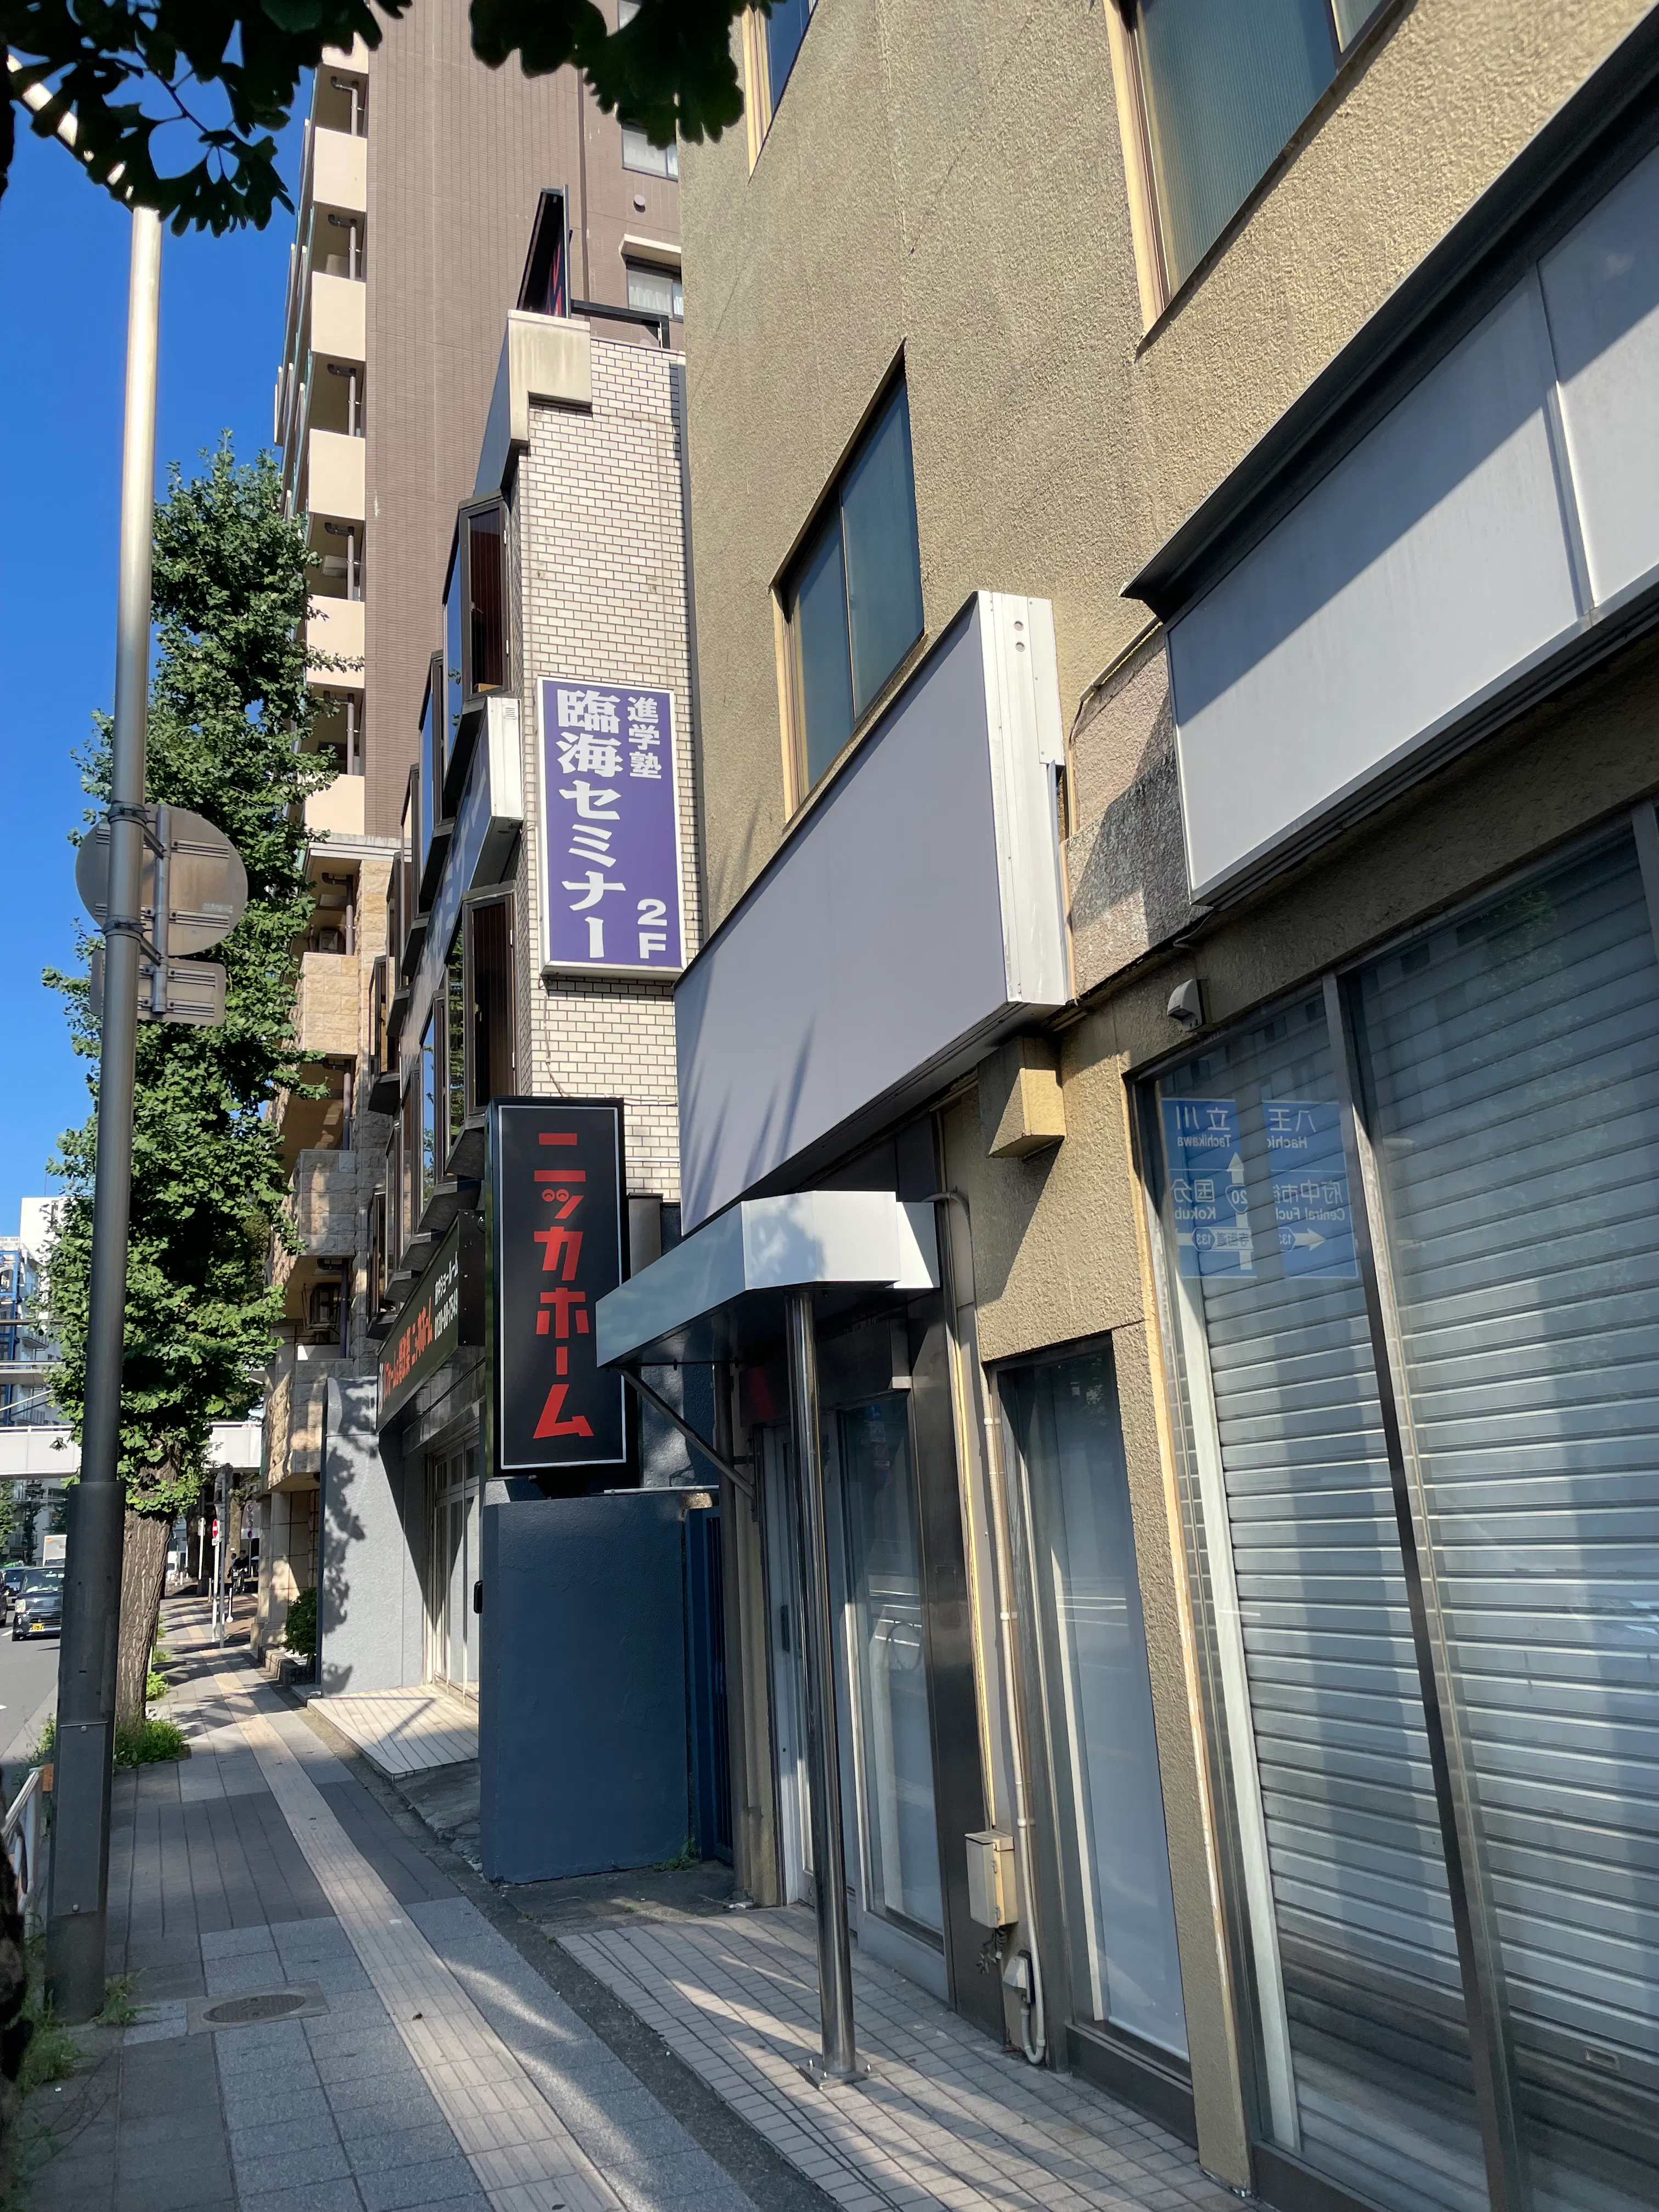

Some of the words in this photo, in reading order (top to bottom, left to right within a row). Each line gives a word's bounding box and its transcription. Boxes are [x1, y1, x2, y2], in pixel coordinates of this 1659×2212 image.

[555, 689, 627, 959] 臨海セミナー
[627, 696, 662, 780] 進学塾
[636, 898, 668, 959] 2F
[533, 1132, 595, 1440] ニッカホーム
